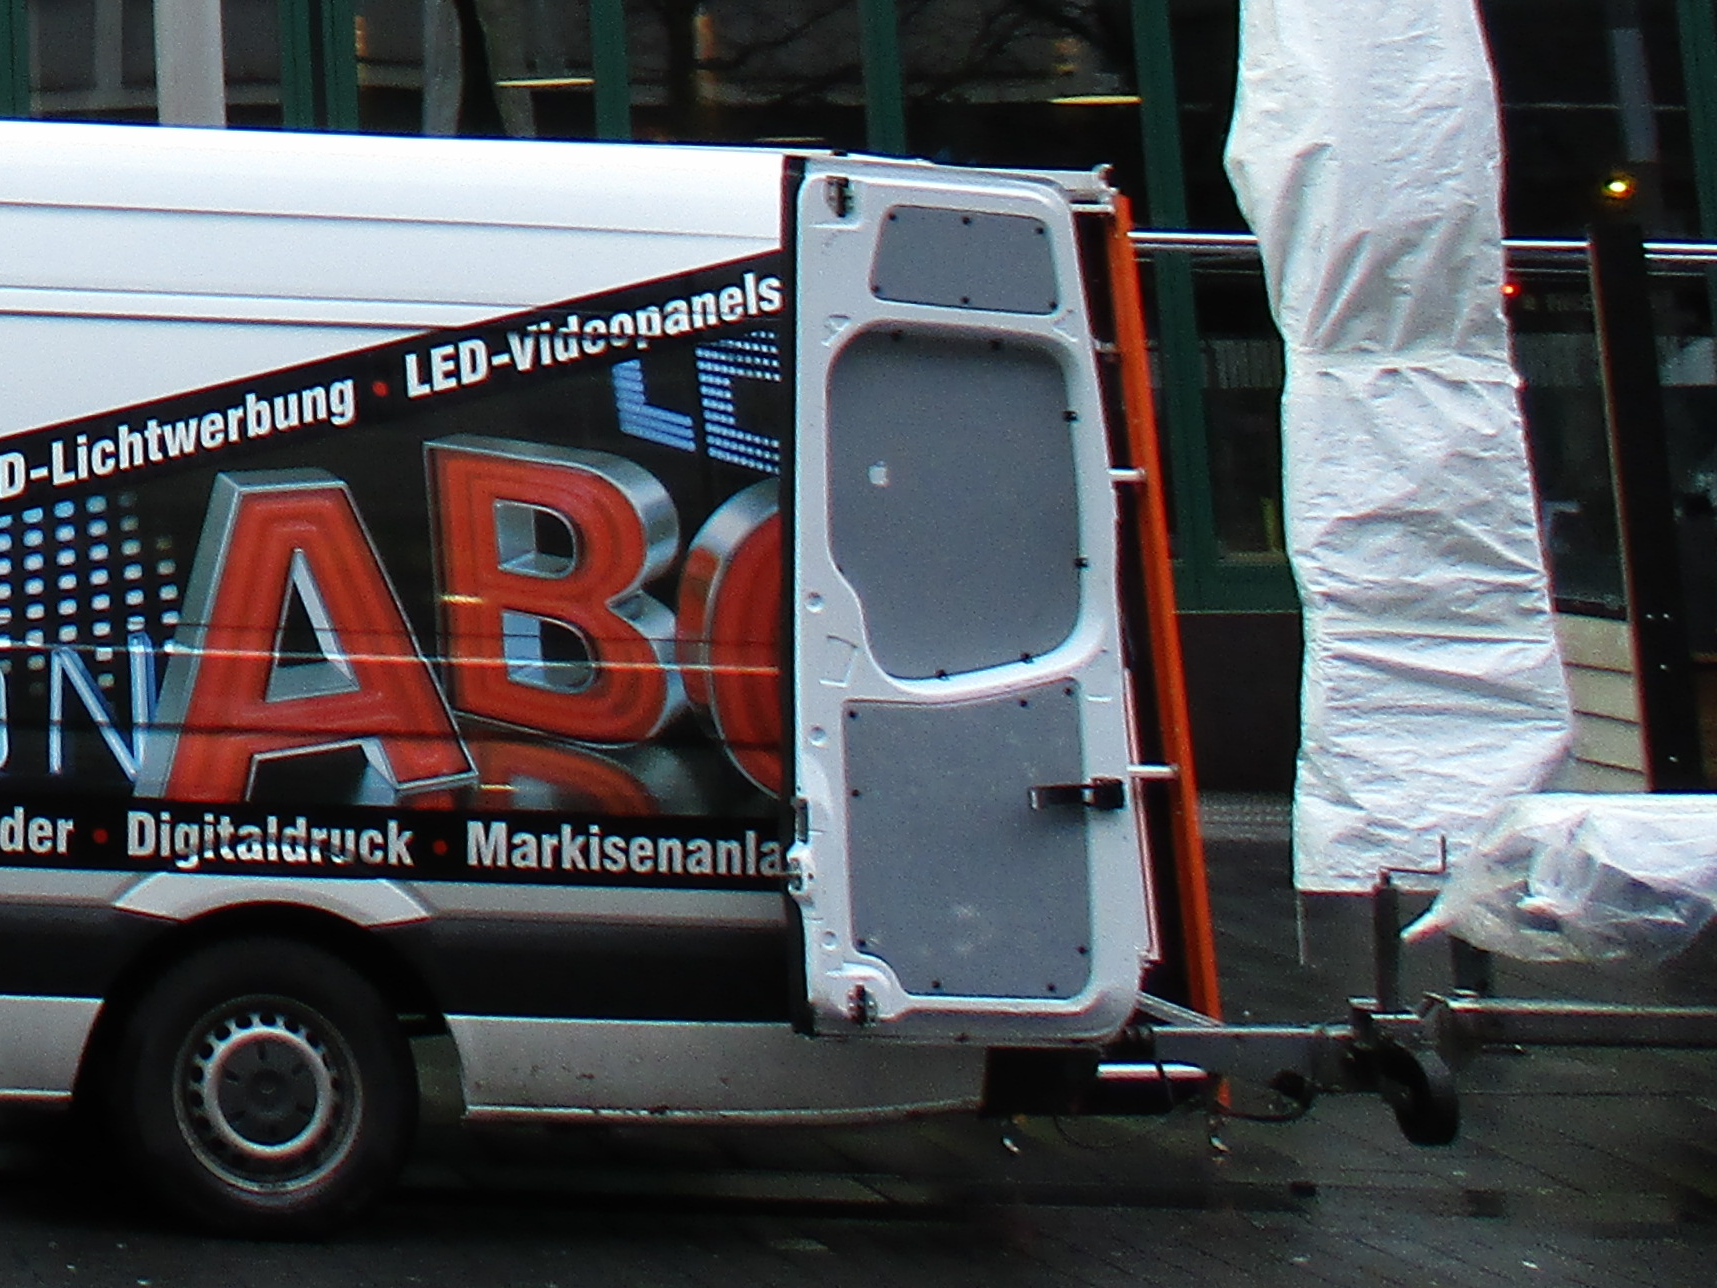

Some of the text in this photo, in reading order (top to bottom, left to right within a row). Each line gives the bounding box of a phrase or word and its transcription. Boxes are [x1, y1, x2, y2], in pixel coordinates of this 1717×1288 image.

[404, 270, 782, 399] LED-Videopanels
[126, 810, 412, 870] Digitaldruck
[466, 821, 782, 877] Markisenanla
